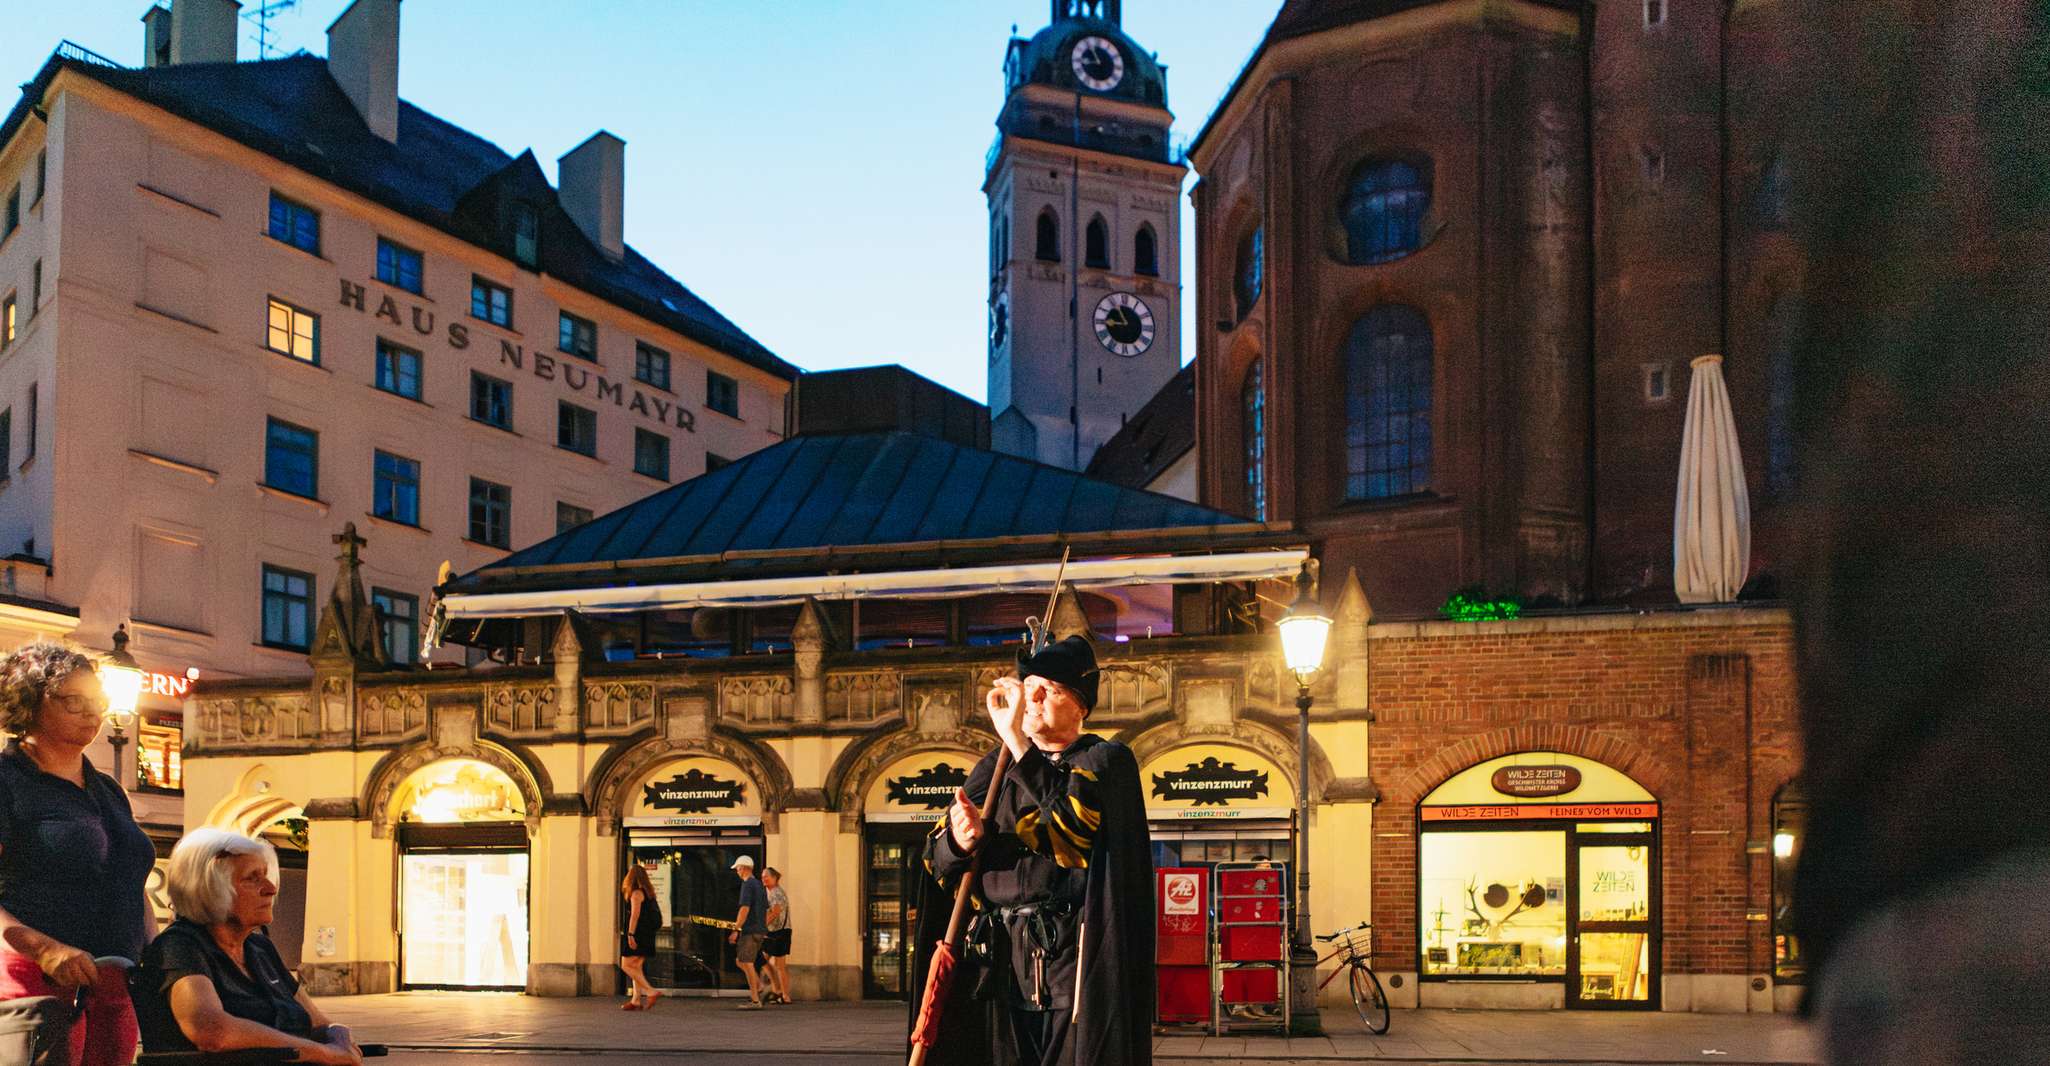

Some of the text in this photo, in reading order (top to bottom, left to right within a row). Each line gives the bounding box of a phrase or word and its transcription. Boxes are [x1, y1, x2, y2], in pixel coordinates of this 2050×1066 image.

[339, 279, 696, 433] HAUS NEUMAYR
[140, 671, 188, 696] ERN
[1507, 769, 1566, 779] WILDE ZEITEN
[1170, 778, 1253, 790] vinzenzmurr
[659, 788, 730, 800] vinzenzmurr
[1177, 808, 1241, 818] vinzenzmurr
[1441, 807, 1642, 818] WILDE ZEITEN FEINES VOM WILD
[663, 815, 719, 826] vinzenzmurr
[1593, 871, 1635, 893] WILDE ZEITEN
